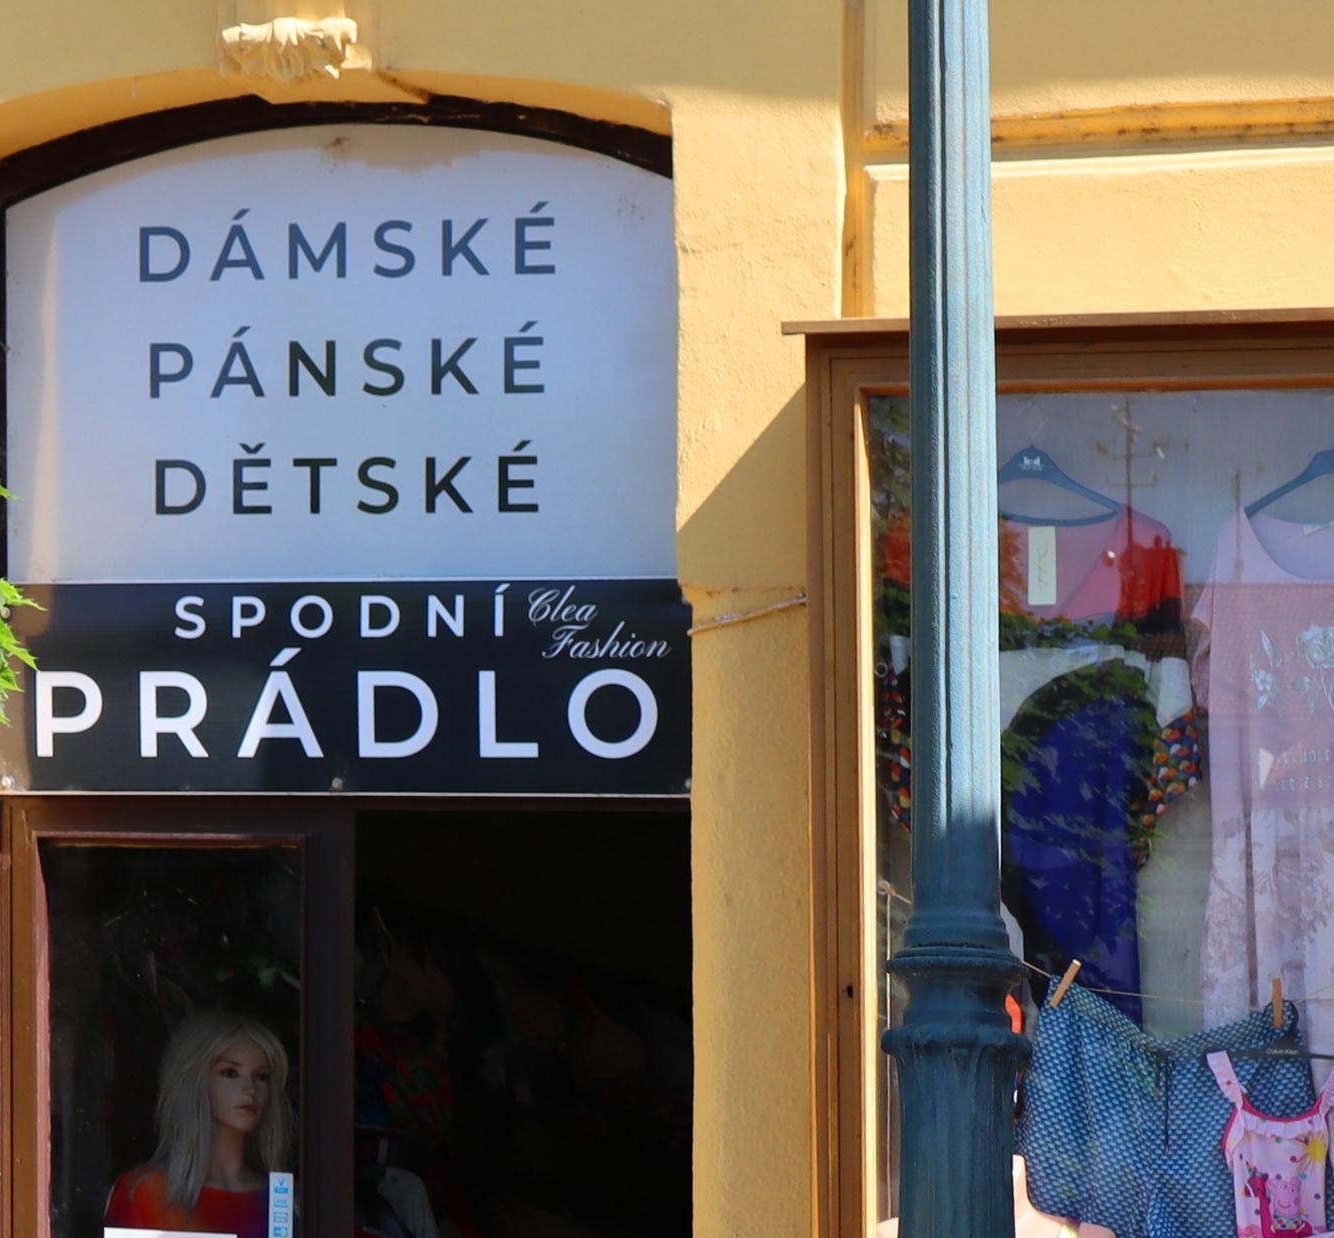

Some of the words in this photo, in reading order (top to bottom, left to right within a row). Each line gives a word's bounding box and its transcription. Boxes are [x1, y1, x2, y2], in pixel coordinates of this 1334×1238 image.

[138, 202, 557, 283] DÁMSKÉ
[148, 321, 545, 399] PÁNSKÉ
[154, 440, 540, 515] DĚTSKÉ
[174, 583, 512, 640] SPODNÍ
[528, 585, 598, 627] Clea
[542, 621, 671, 659] Fashion
[34, 648, 660, 760] PRÁDLO
